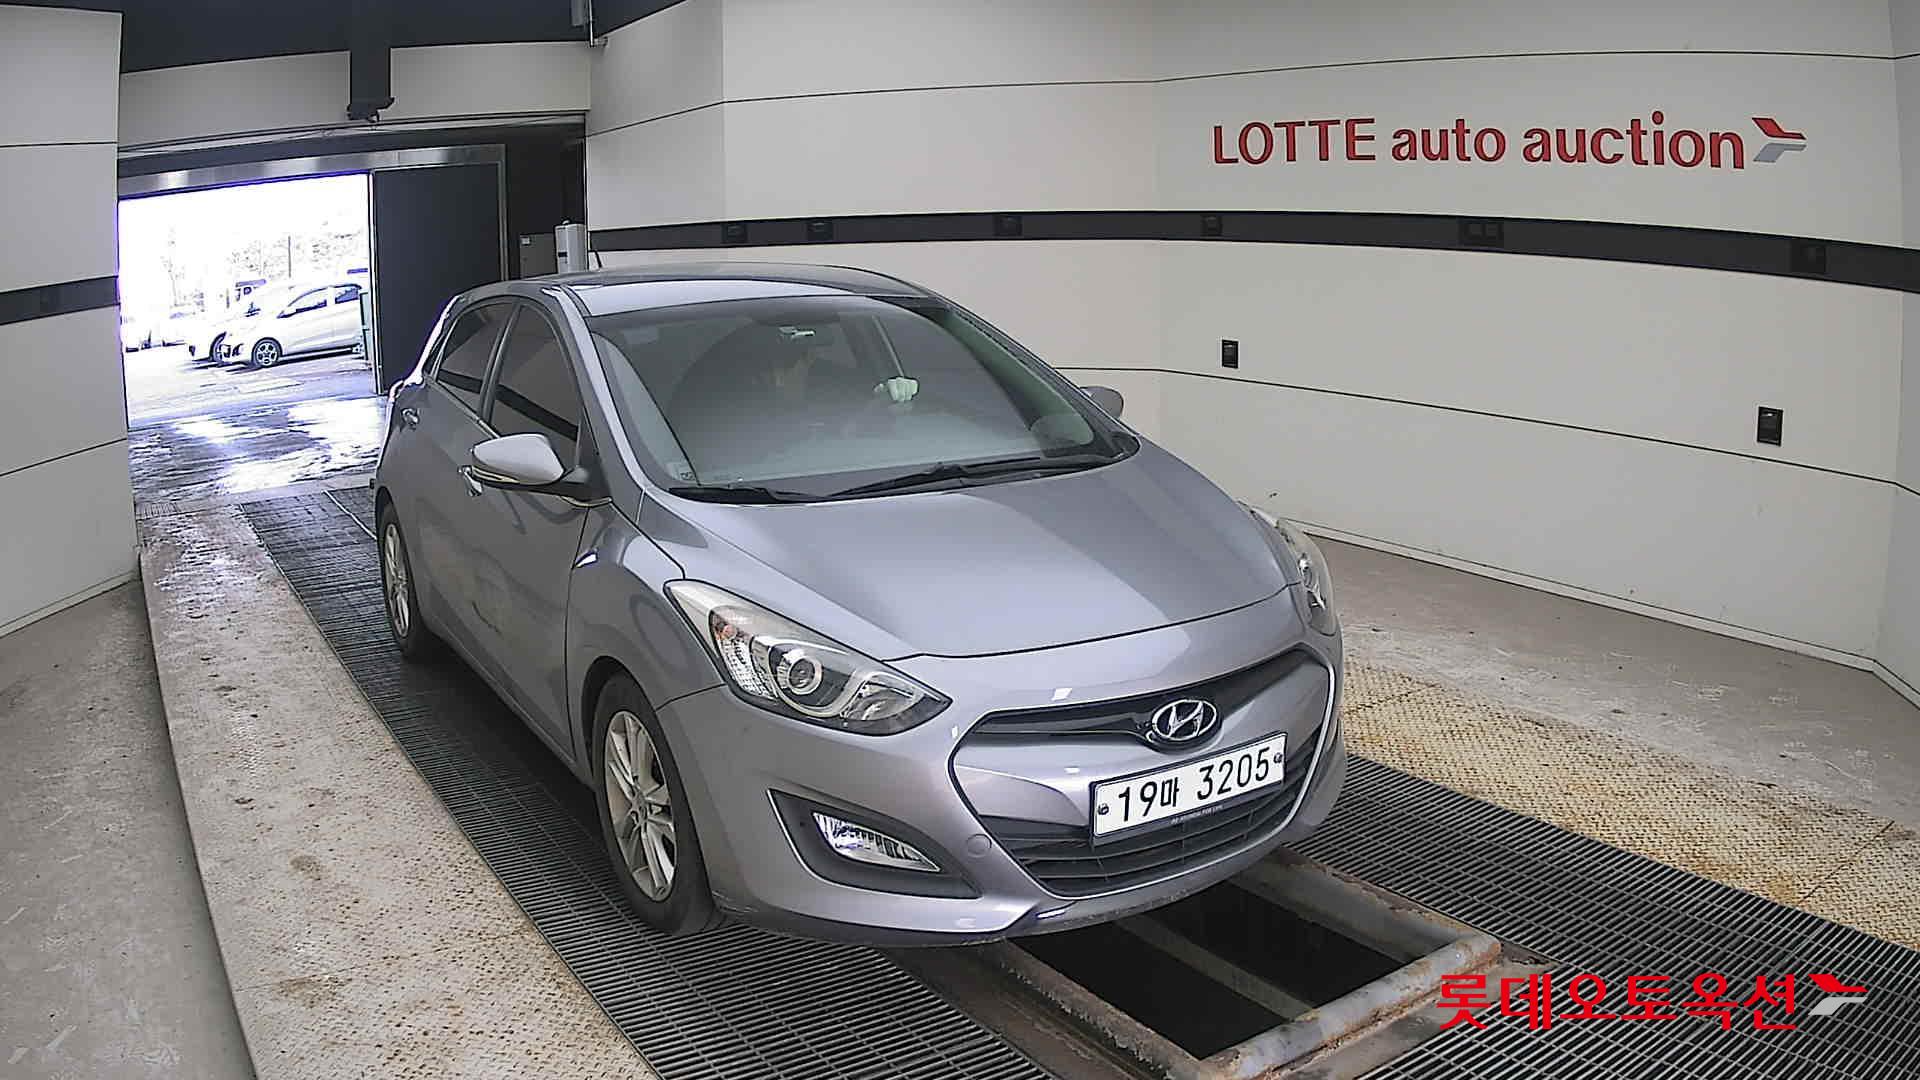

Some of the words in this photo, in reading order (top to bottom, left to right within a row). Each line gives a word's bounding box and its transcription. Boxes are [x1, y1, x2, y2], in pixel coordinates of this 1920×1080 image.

[1213, 118, 1376, 165] LOTTE
[1391, 118, 1507, 162] auto
[1522, 111, 1745, 169] auction
[1118, 776, 1180, 822] 19마
[1197, 746, 1270, 800] 3205
